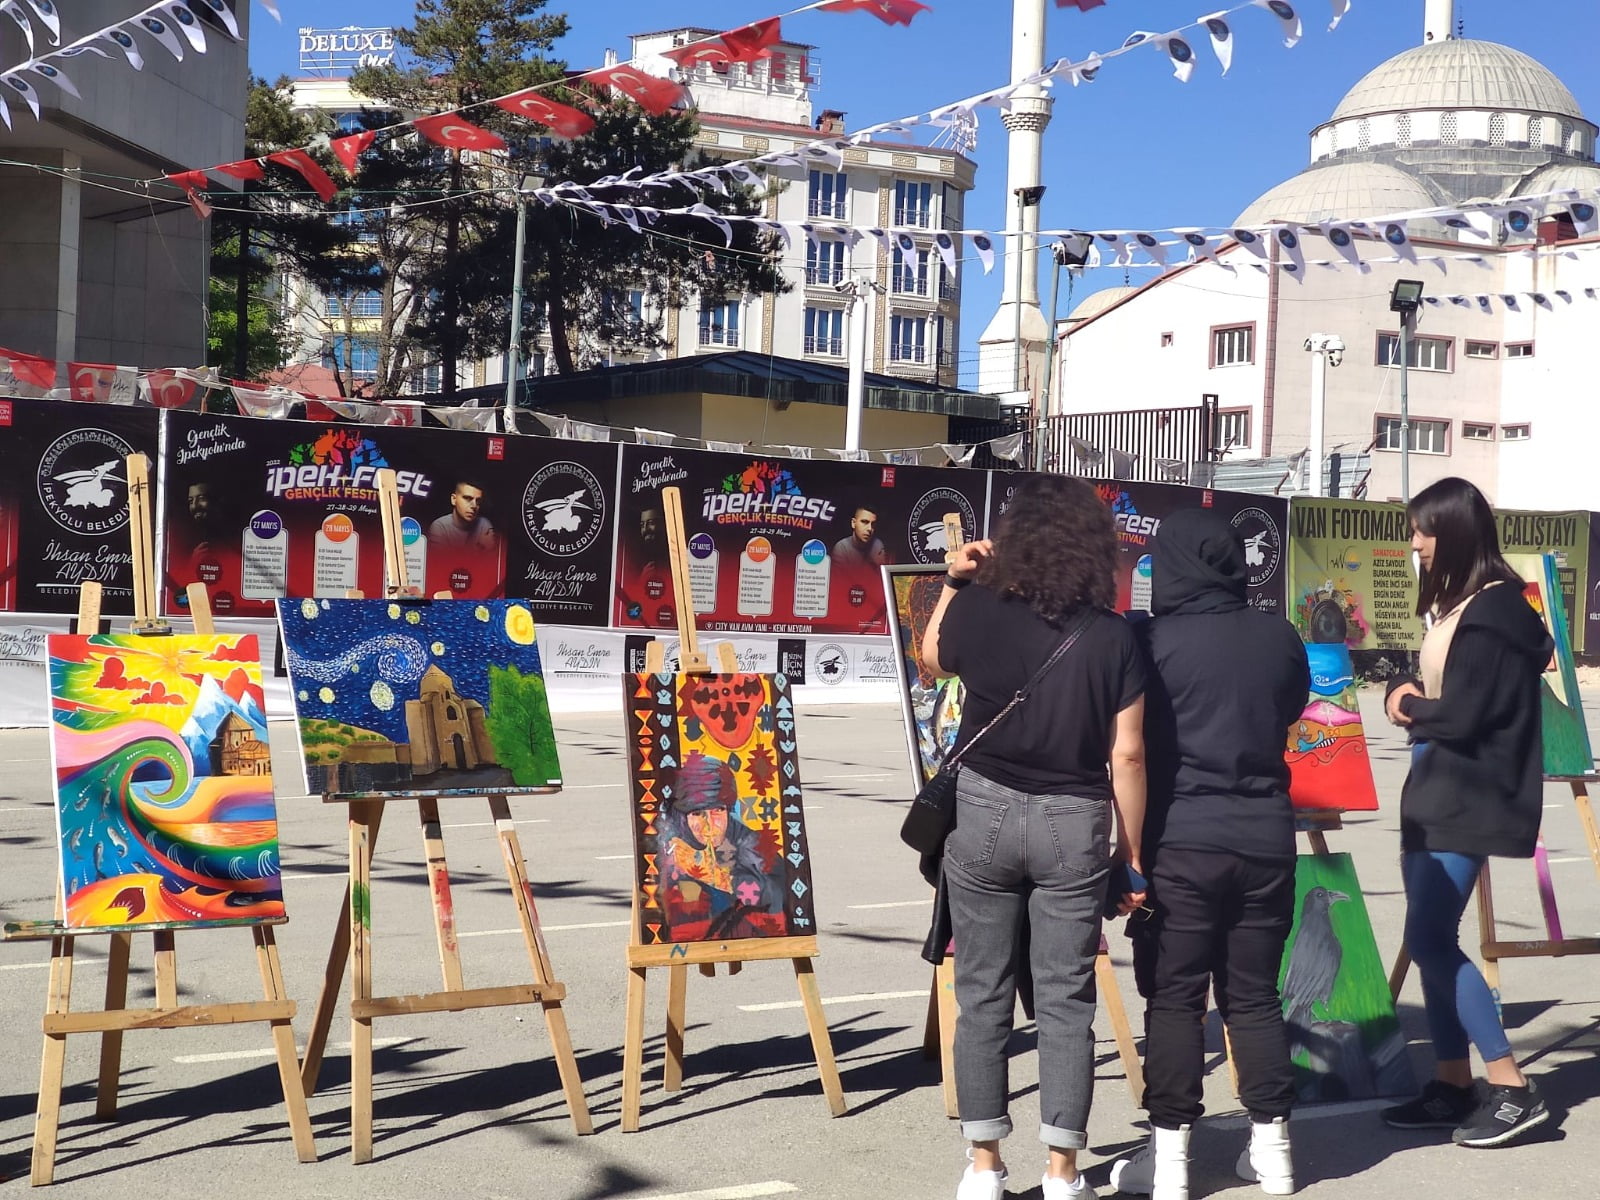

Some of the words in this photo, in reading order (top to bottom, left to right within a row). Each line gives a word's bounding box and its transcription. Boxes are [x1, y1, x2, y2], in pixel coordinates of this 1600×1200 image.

[299, 31, 394, 52] DELUXE
[187, 423, 230, 449] Gençlik
[641, 456, 676, 478] Gençlik
[87, 504, 130, 531] BELEDİY
[1295, 506, 1327, 539] VAN
[1502, 514, 1577, 551] ÇALIŞTAYI
[42, 539, 91, 562] İhsan
[56, 562, 119, 584] AYDIN
[525, 560, 562, 580] İhsan
[565, 565, 598, 582] Emre
[40, 587, 80, 595] BELEDİY
[535, 580, 582, 600] AYDIN
[789, 669, 802, 677] VAR
[1493, 1101, 1524, 1125] N
